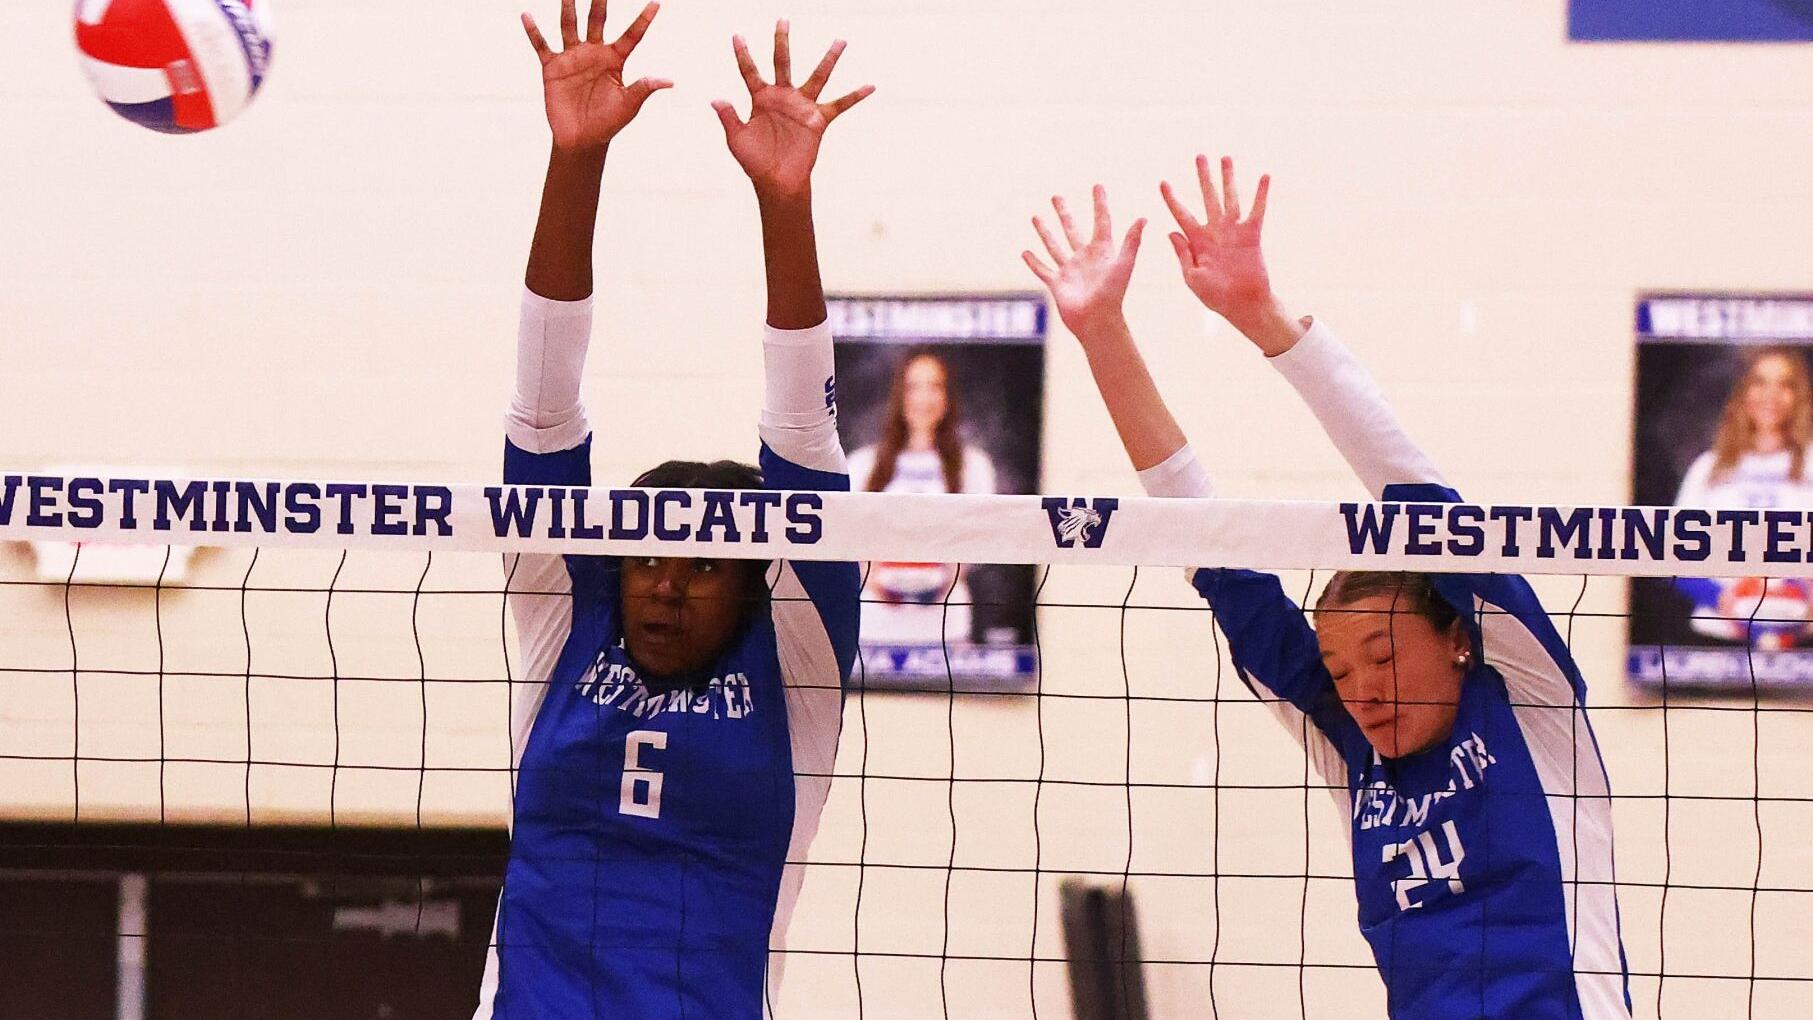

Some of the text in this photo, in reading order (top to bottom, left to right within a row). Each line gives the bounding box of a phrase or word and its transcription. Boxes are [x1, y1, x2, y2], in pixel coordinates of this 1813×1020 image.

[483, 487, 823, 544] WILDCATS
[1040, 497, 1119, 549] W
[1339, 503, 1813, 564] WESTMINSTE
[575, 651, 754, 720] WESTMNSTER
[618, 730, 668, 820] 6
[1382, 819, 1466, 911] 24
